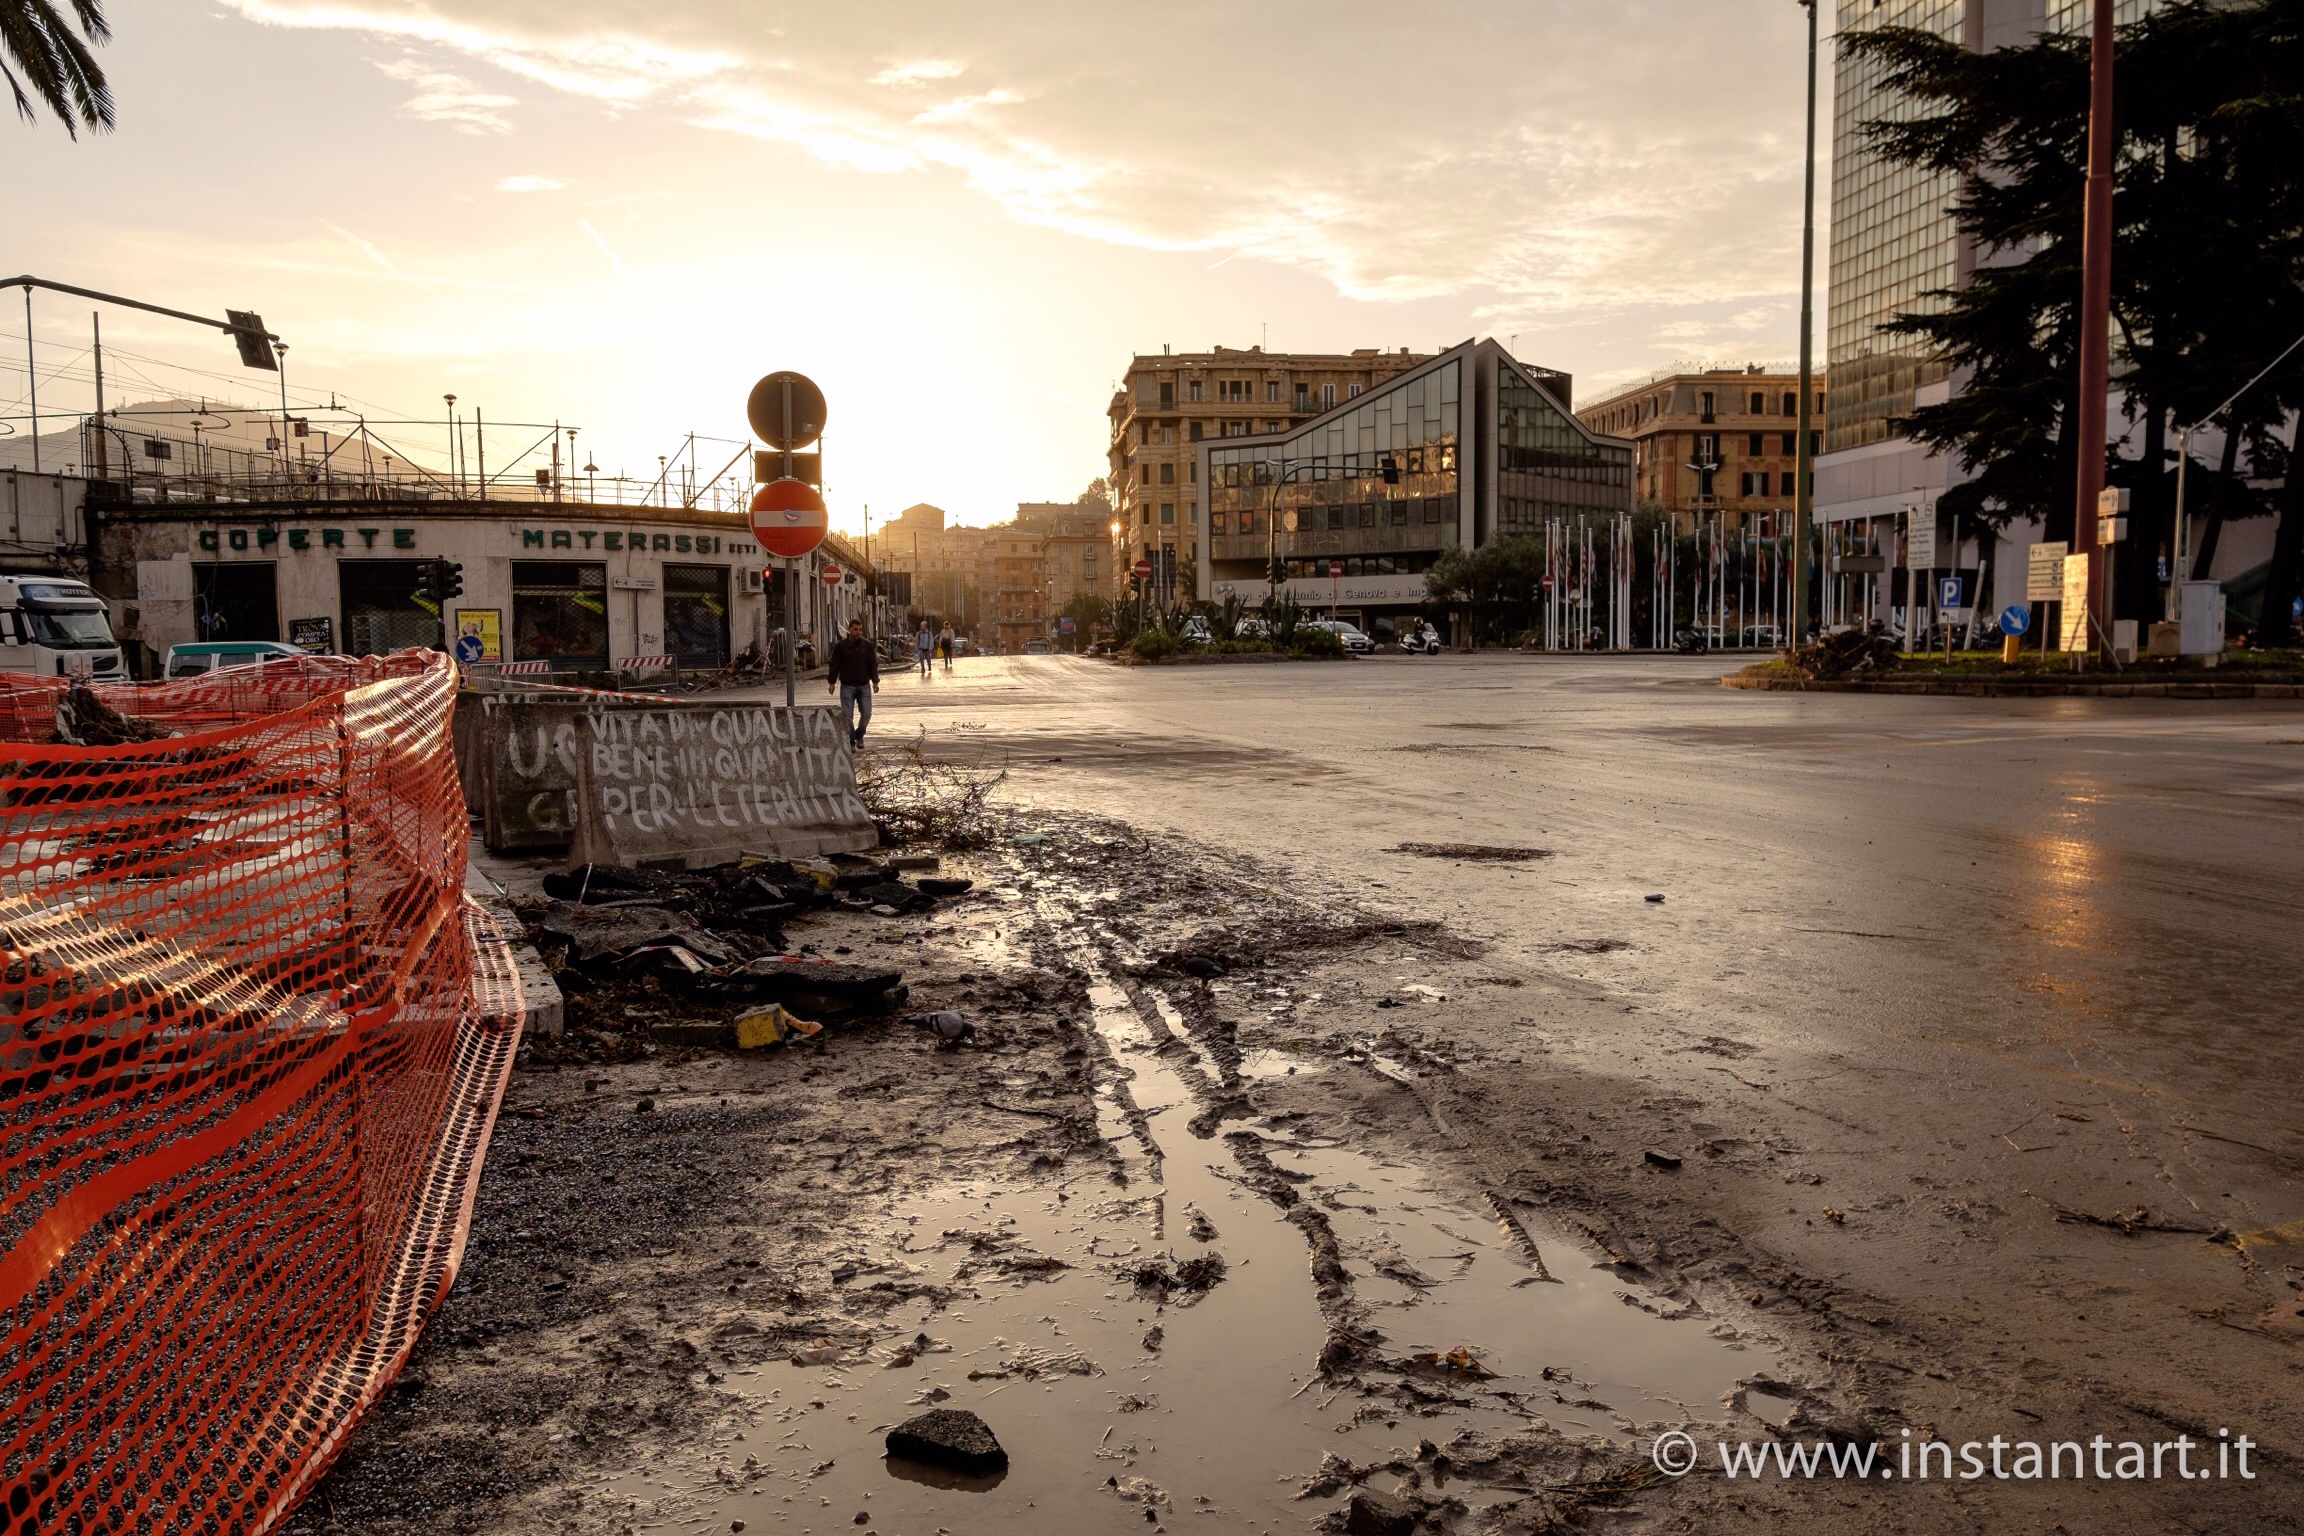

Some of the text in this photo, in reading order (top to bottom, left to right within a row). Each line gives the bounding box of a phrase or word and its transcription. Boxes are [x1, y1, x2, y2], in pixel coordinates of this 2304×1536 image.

[199, 528, 416, 550] COPERTE
[523, 529, 721, 554] MATERASSI
[1344, 588, 1387, 599] Genova
[1392, 588, 1401, 598] e
[587, 711, 666, 746] VITA
[593, 743, 673, 781] BENE
[603, 782, 682, 832] PER
